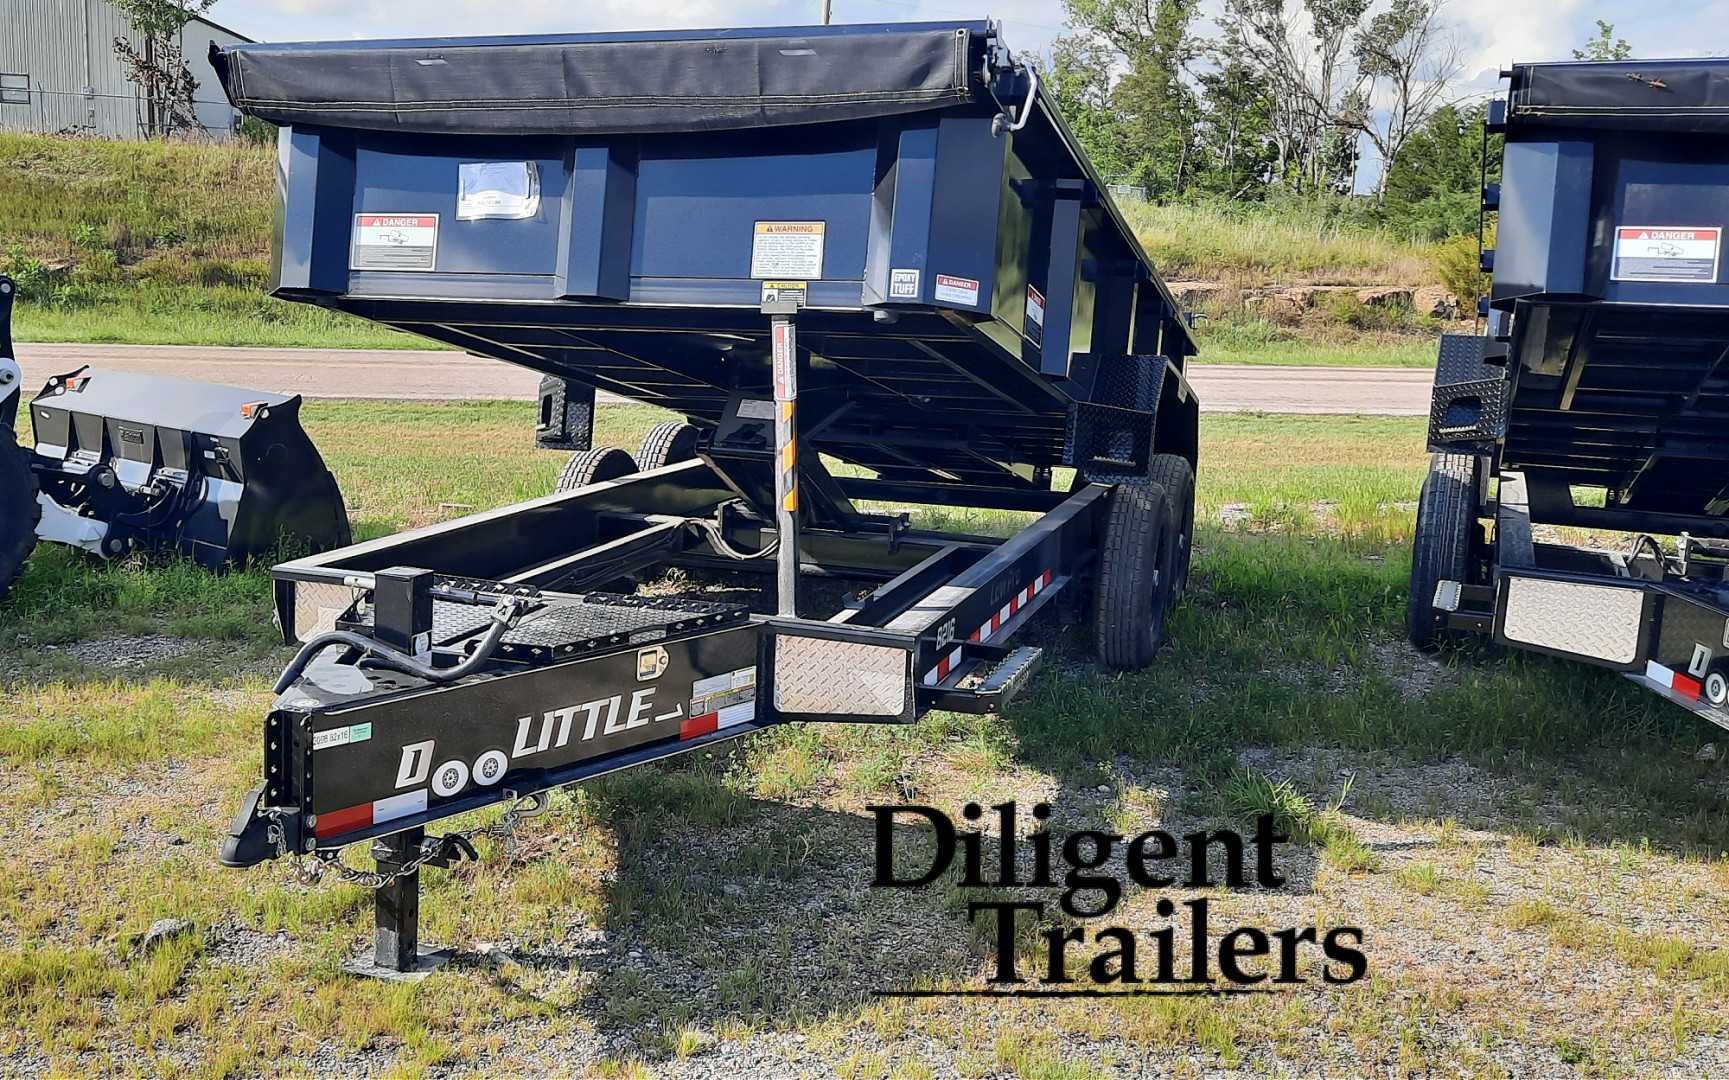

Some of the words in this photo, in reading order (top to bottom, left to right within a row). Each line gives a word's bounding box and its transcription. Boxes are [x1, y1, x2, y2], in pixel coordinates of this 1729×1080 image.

[382, 218, 418, 227] DANGER
[775, 225, 813, 233] WARNING
[1651, 231, 1695, 240] DANGER
[895, 273, 915, 282] EPOXY
[894, 283, 915, 294] TUFF
[948, 279, 972, 290] DANGER
[776, 342, 784, 375] DANGER
[936, 617, 956, 651] 8216
